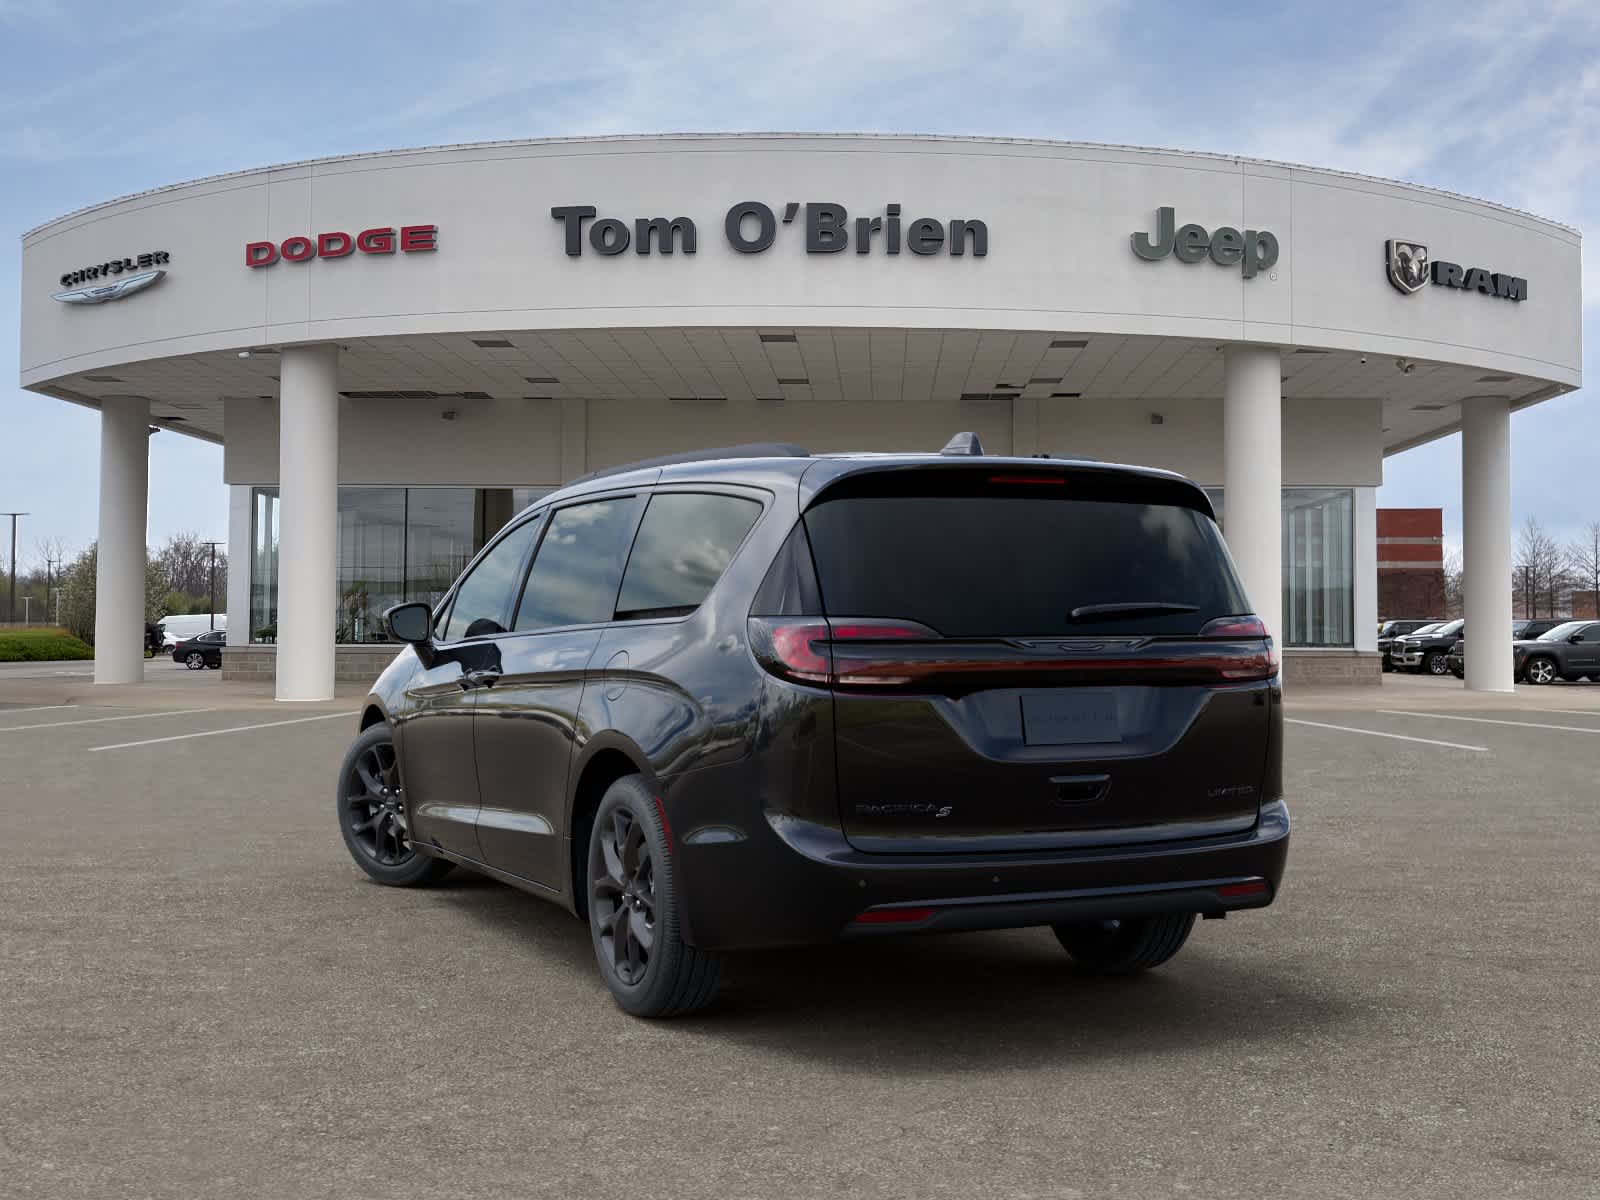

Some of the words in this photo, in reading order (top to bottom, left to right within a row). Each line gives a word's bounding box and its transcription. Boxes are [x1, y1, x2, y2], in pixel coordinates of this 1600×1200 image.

[245, 225, 438, 268] DODGE
[551, 206, 697, 256] Tom
[725, 202, 988, 256] O'Brien
[1131, 207, 1279, 279] Jeep
[60, 251, 169, 286] CHRYSLER
[1431, 261, 1528, 302] RAM
